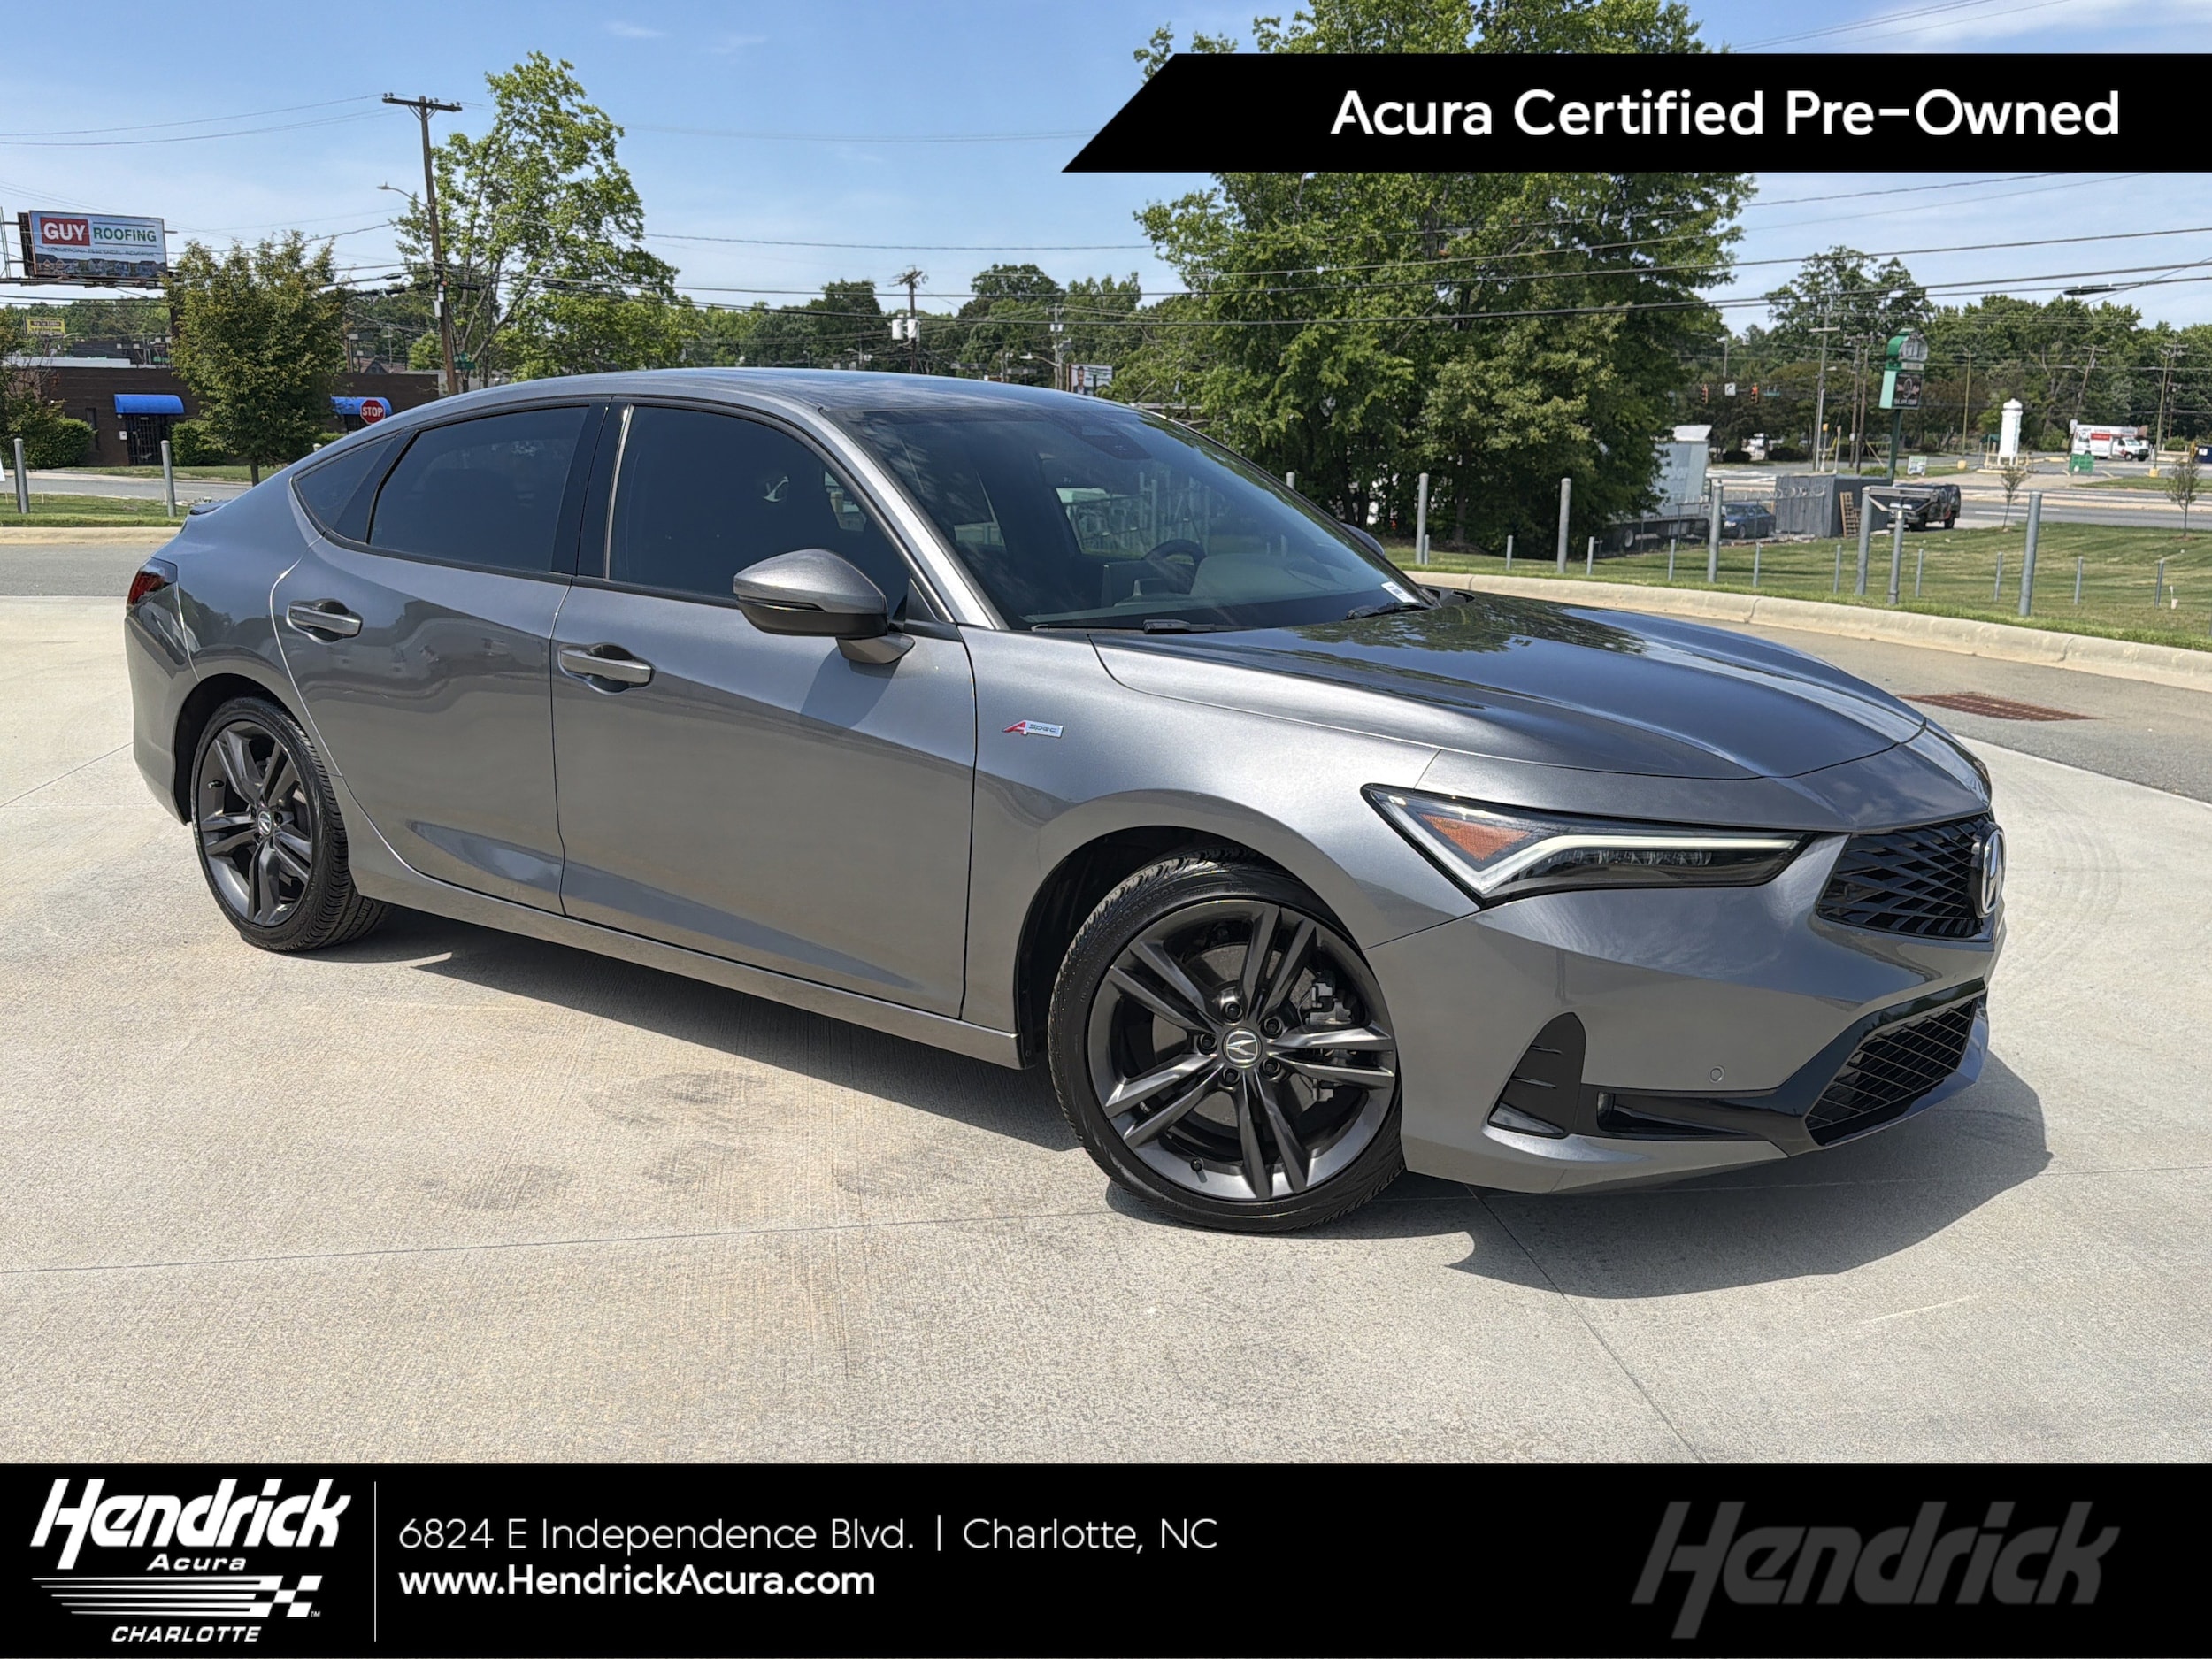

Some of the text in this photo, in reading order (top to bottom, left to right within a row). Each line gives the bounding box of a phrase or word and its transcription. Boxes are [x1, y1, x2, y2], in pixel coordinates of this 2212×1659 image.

[43, 222, 157, 242] GUY ROOFING
[362, 406, 384, 417] STOP
